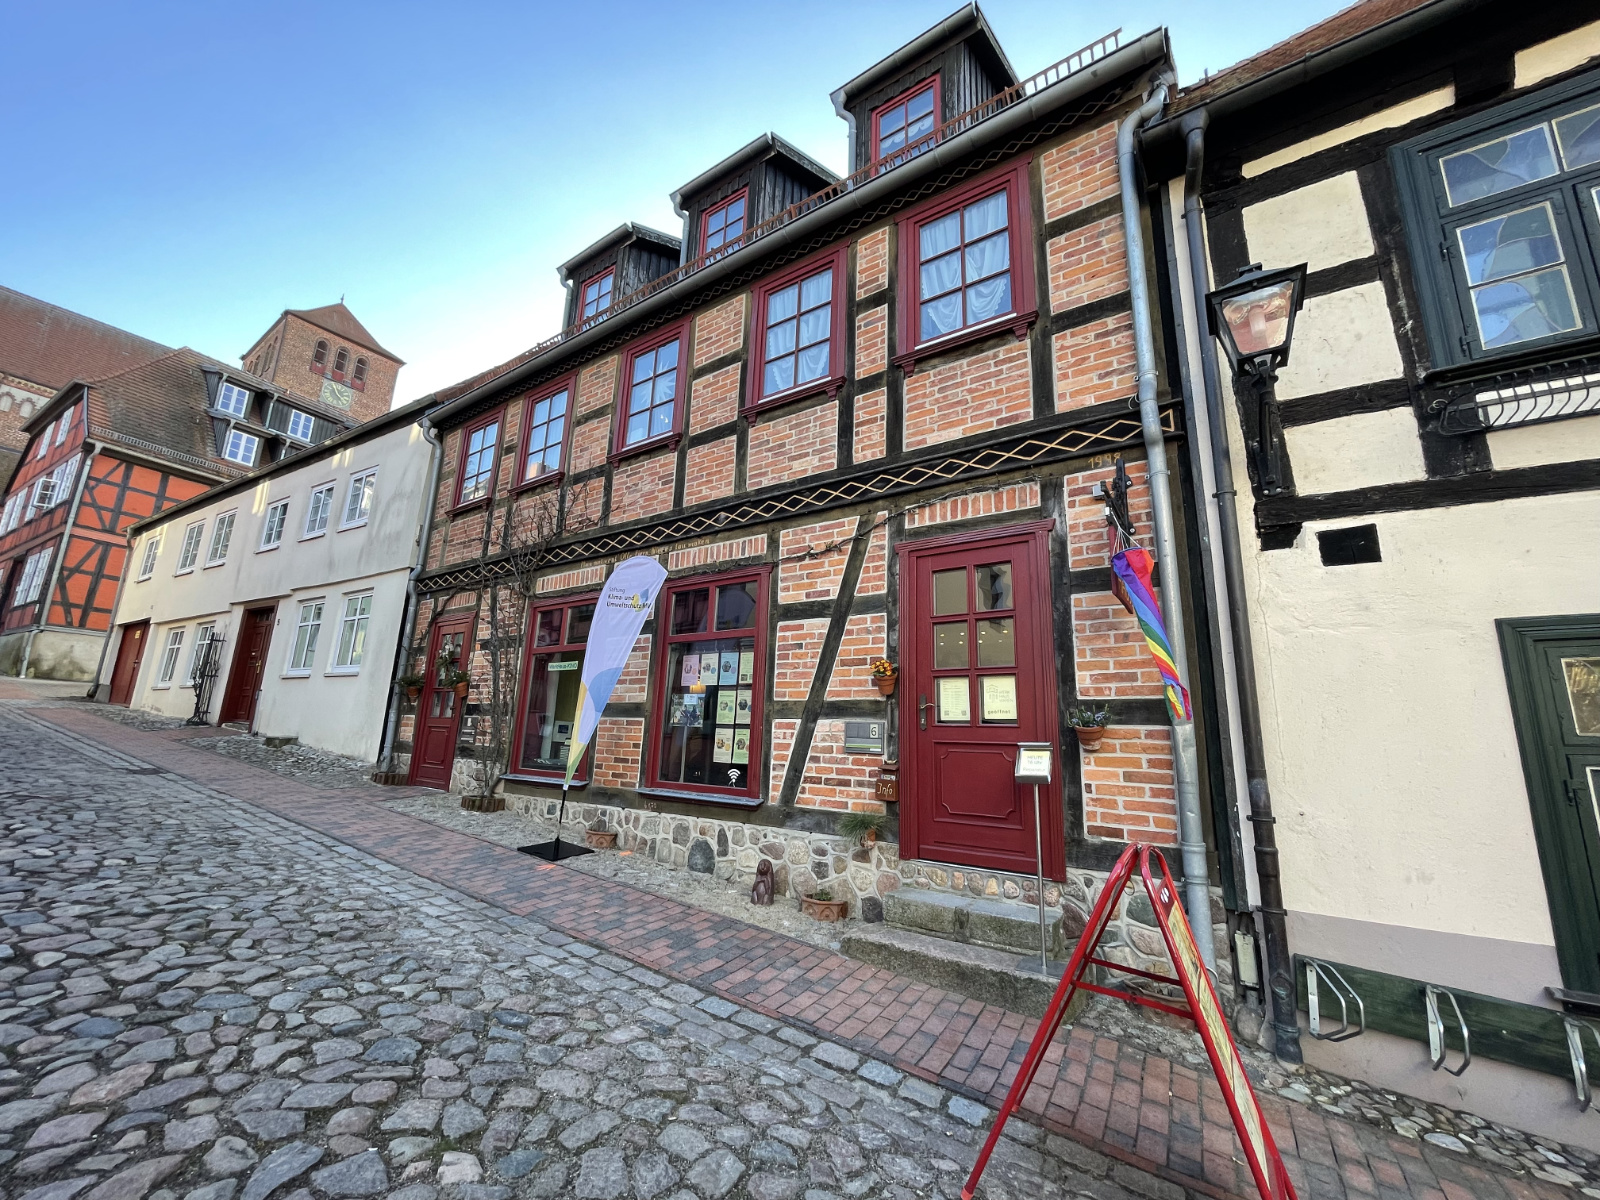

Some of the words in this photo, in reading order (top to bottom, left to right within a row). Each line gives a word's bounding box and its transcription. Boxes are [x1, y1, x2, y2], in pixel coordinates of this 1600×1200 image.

[1088, 452, 1121, 468] 1998
[606, 601, 641, 609] Umweltschutz
[871, 727, 876, 736] 6
[877, 782, 893, 798] Info
